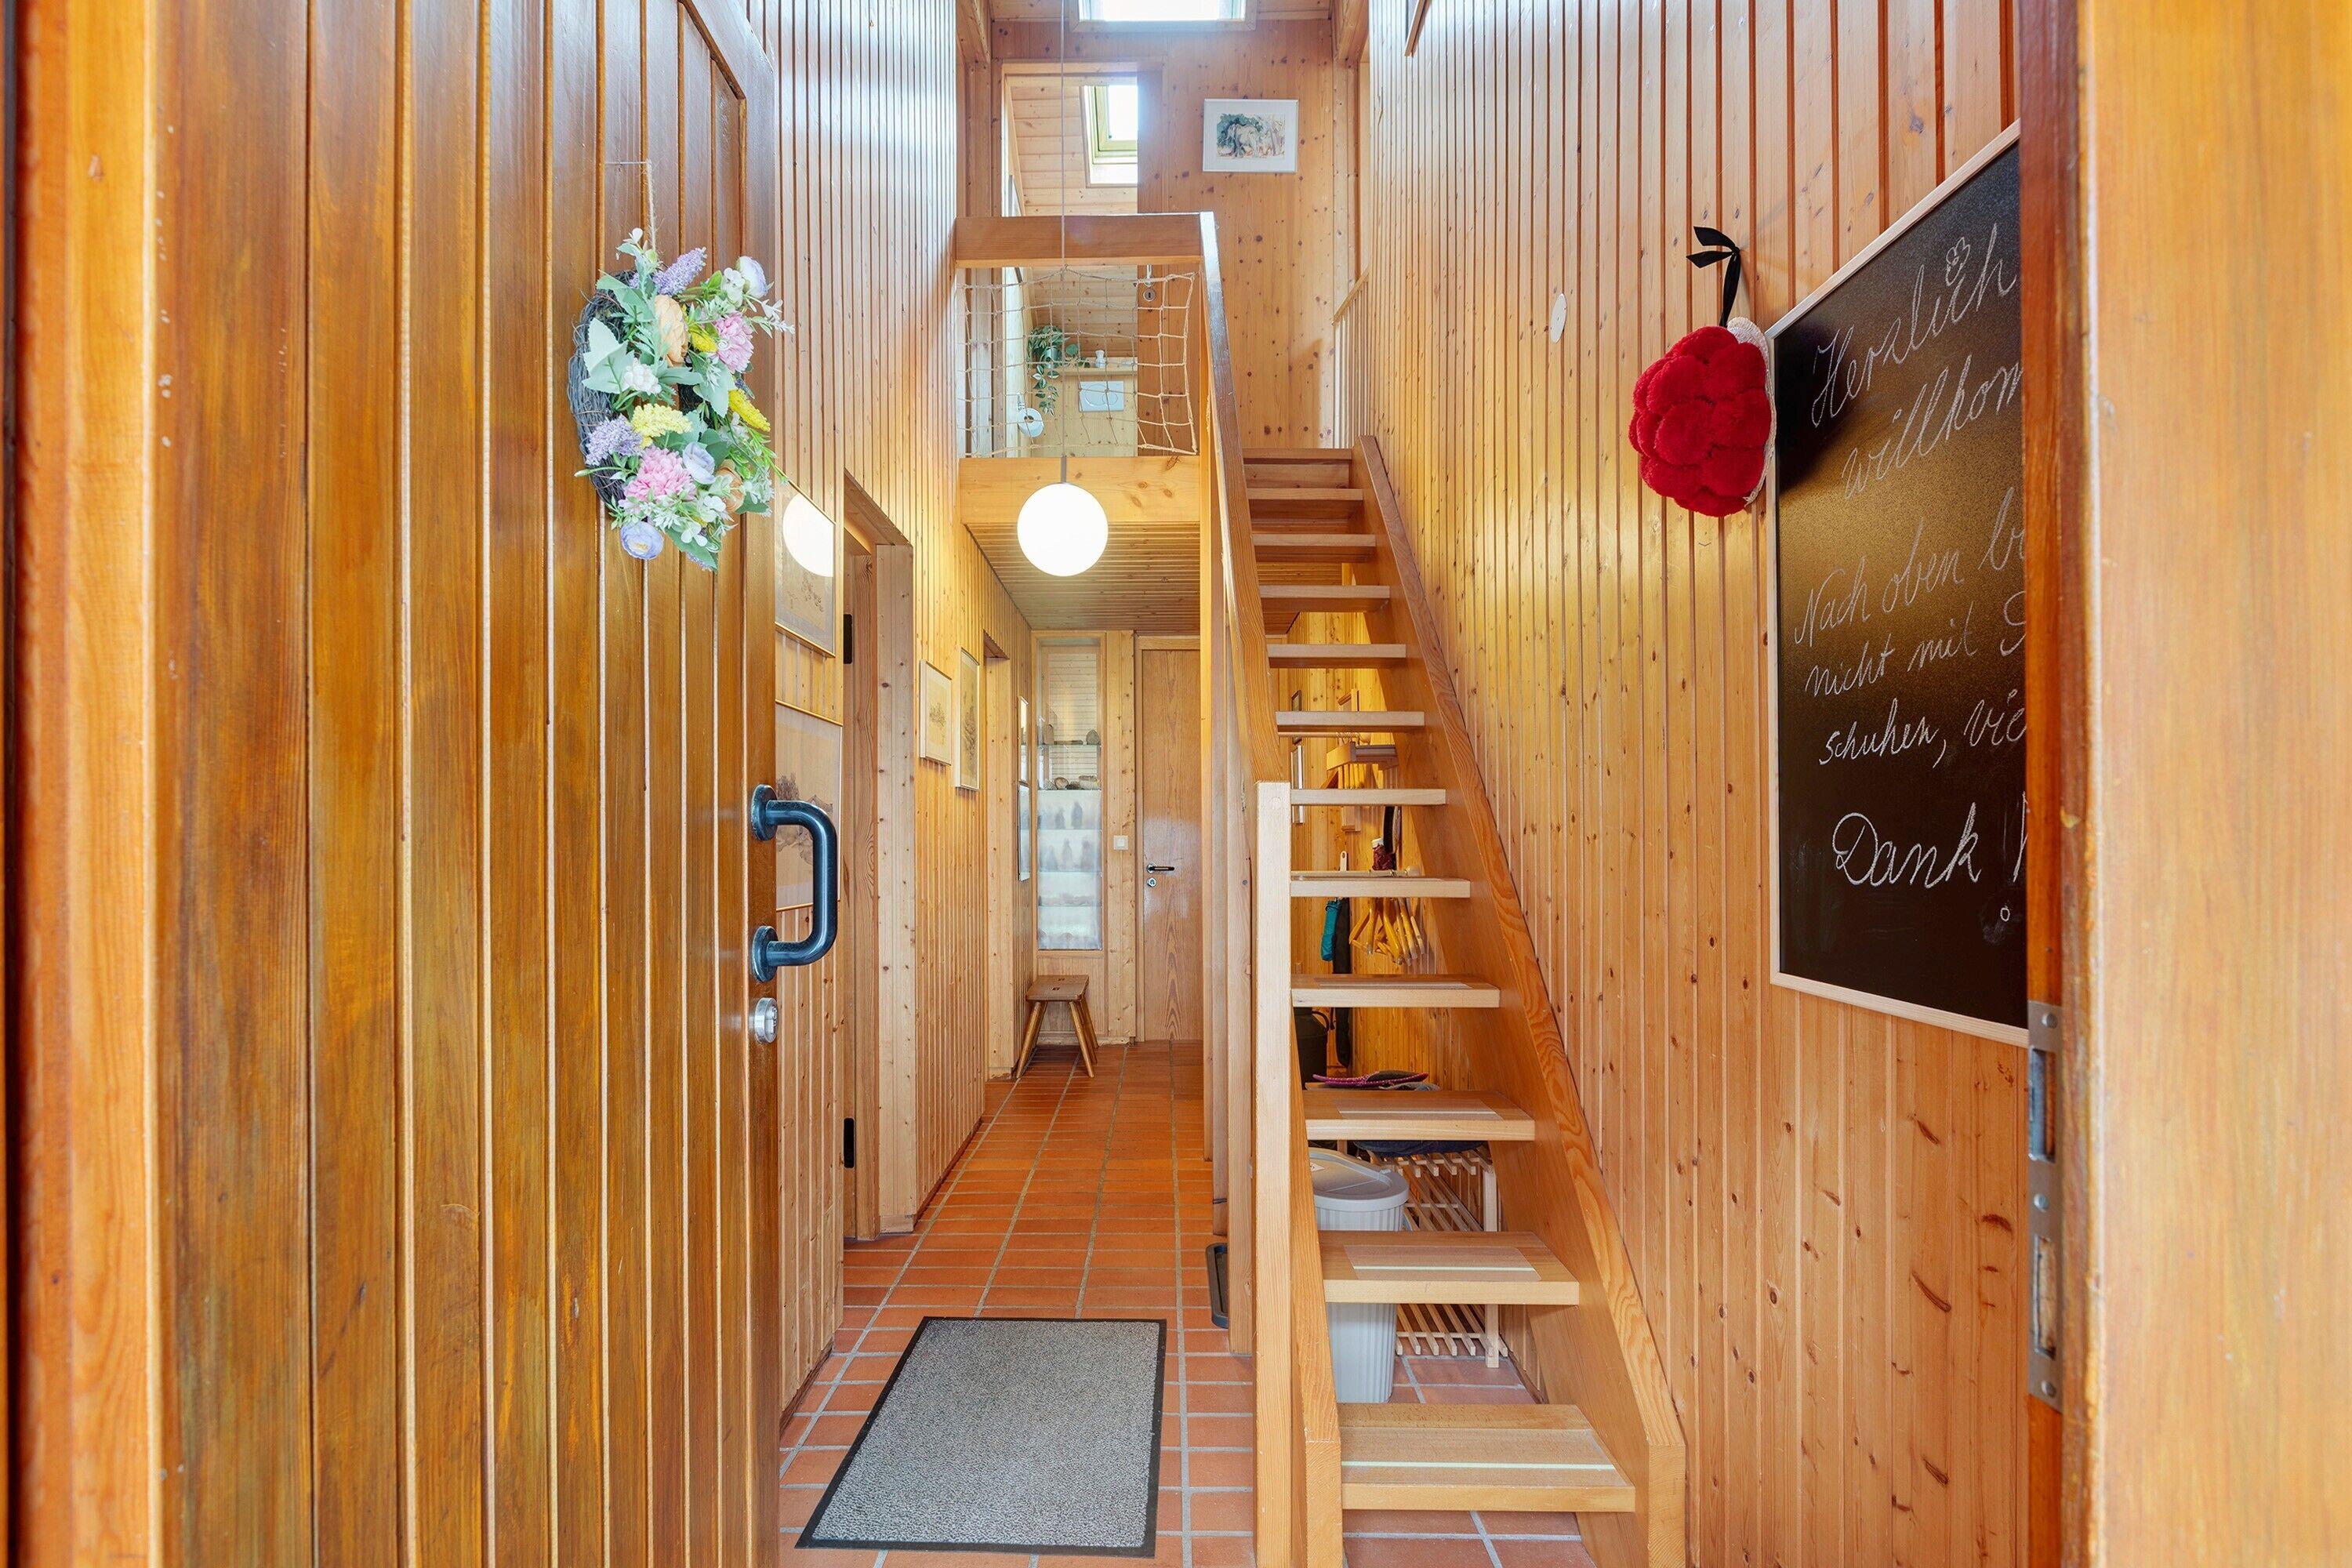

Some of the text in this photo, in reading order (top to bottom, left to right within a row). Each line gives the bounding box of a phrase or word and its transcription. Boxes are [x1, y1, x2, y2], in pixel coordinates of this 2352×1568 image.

[1811, 223, 2017, 428] Herzlich
[1794, 555, 1871, 648] Nach
[1882, 515, 1965, 613] oben
[1805, 633, 1895, 697] nicht
[1907, 601, 1976, 673] mit
[1831, 801, 1982, 889] Dank
